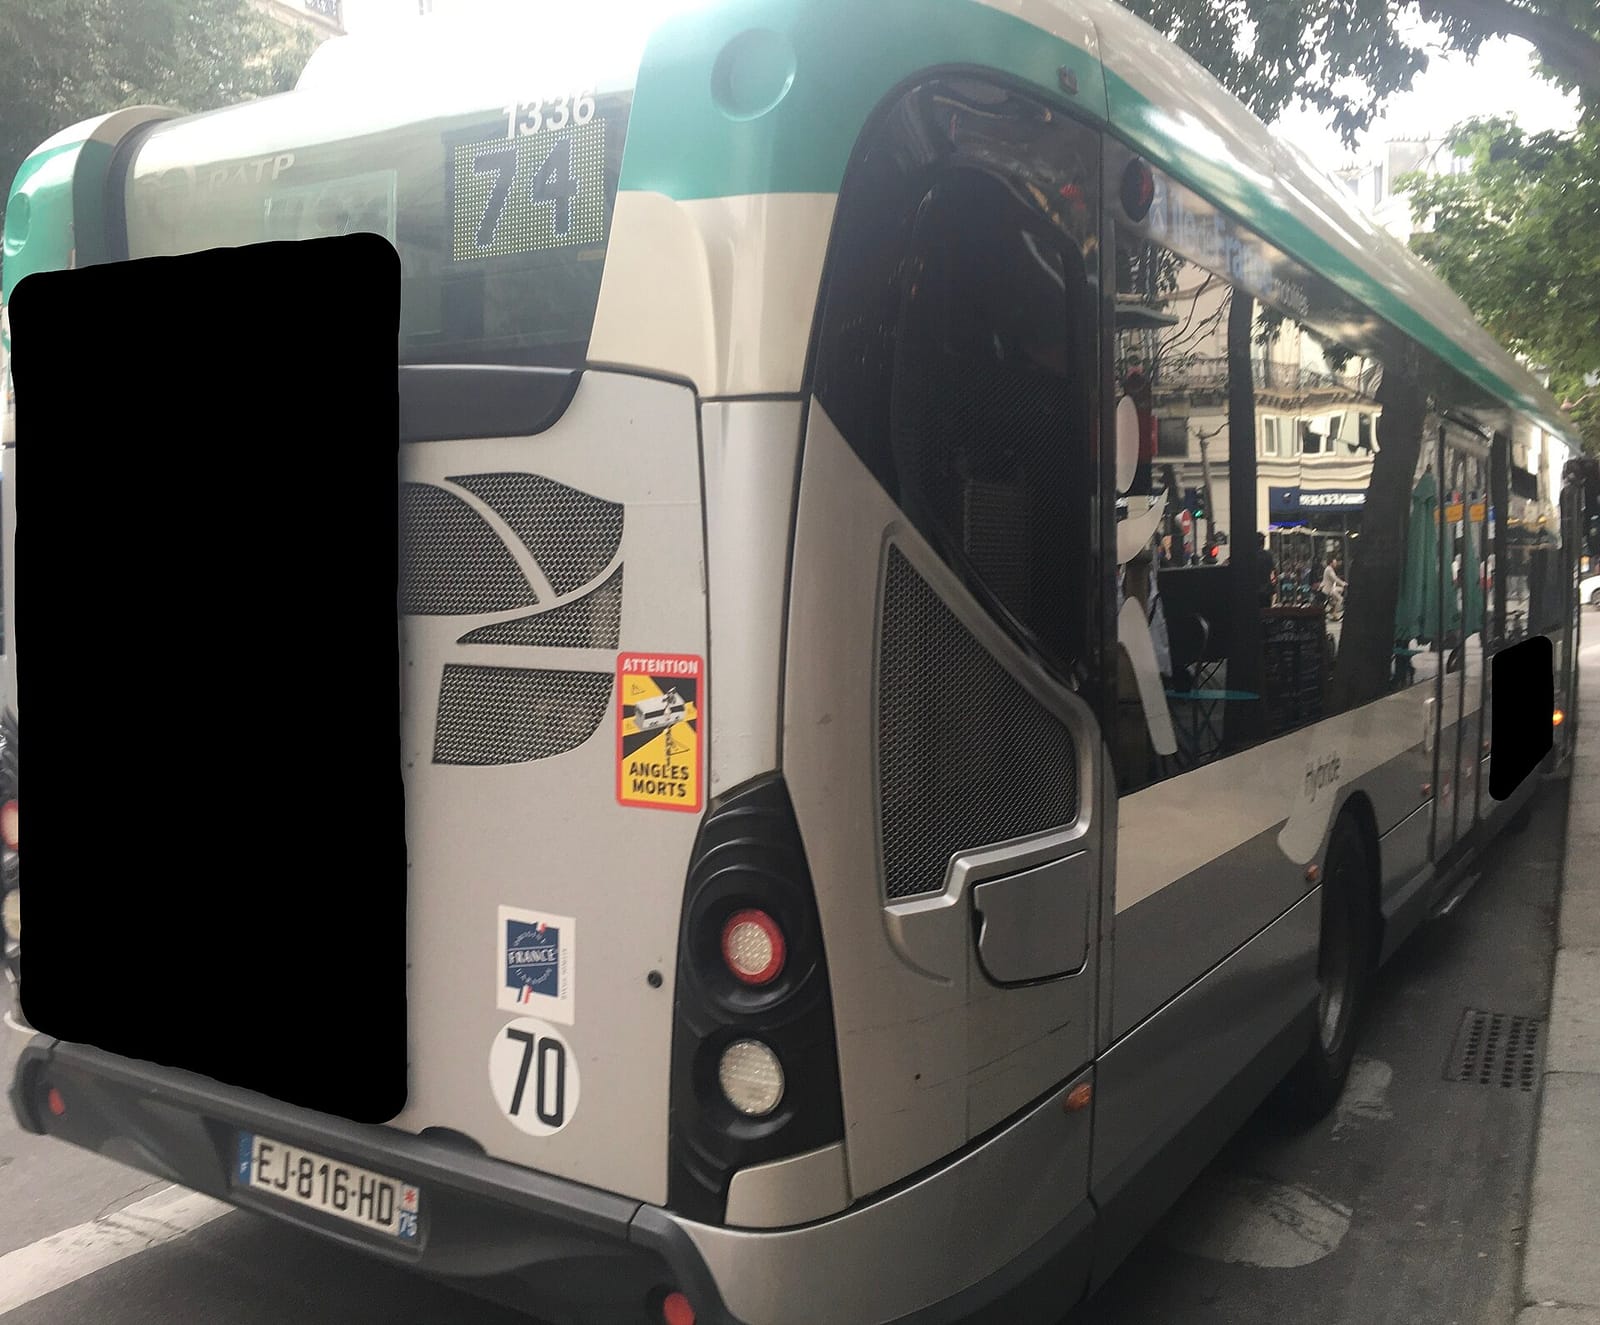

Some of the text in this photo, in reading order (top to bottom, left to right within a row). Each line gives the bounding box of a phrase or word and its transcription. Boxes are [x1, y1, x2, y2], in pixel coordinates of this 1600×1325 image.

[502, 88, 595, 140] 1336
[472, 135, 579, 249] 74
[623, 658, 698, 674] ATTENTION
[629, 761, 689, 780] ANGLES
[632, 779, 686, 797] MORTS
[508, 948, 557, 965] FRANCE
[507, 1028, 564, 1128] 70
[400, 1212, 418, 1237] 75
